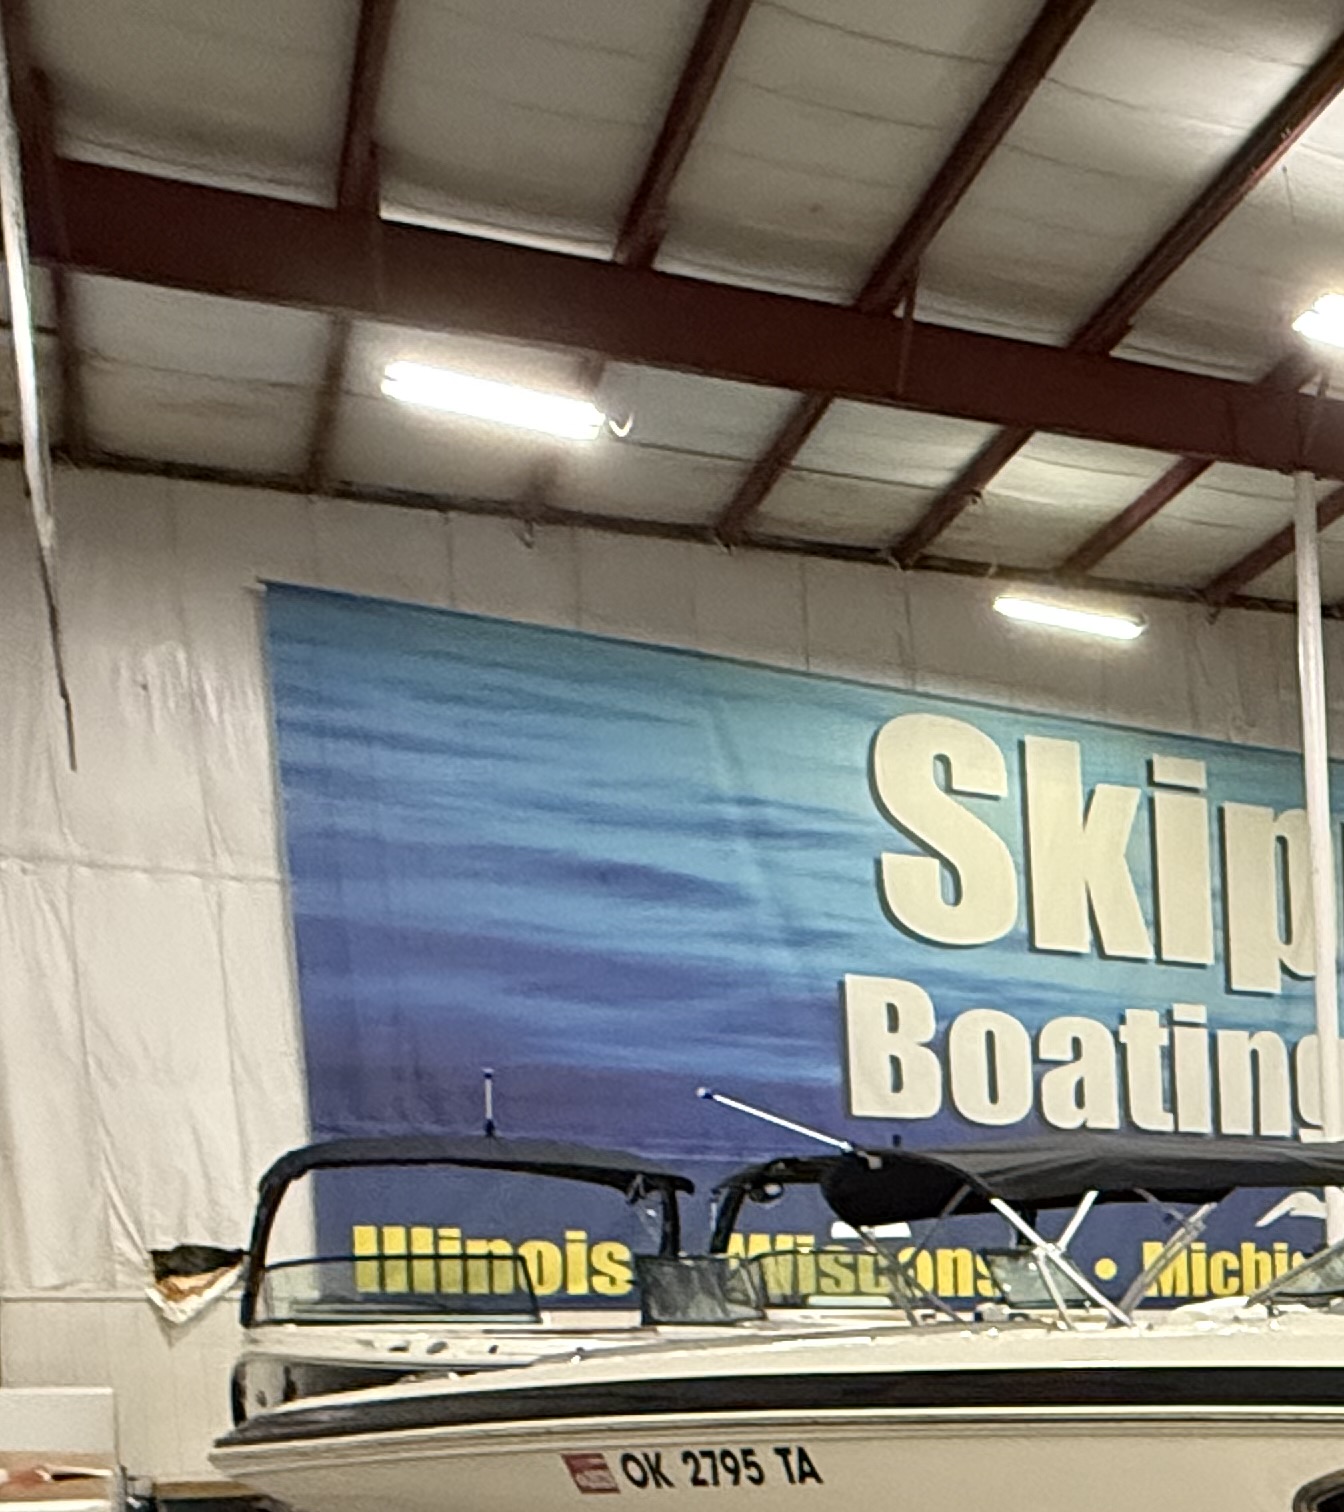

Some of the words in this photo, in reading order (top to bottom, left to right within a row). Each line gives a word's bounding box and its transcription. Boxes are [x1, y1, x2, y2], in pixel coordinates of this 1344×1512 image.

[352, 1225, 635, 1296] Illinois
[620, 1451, 675, 1489] OK
[681, 1447, 765, 1486] 2795
[772, 1446, 824, 1485] TA
